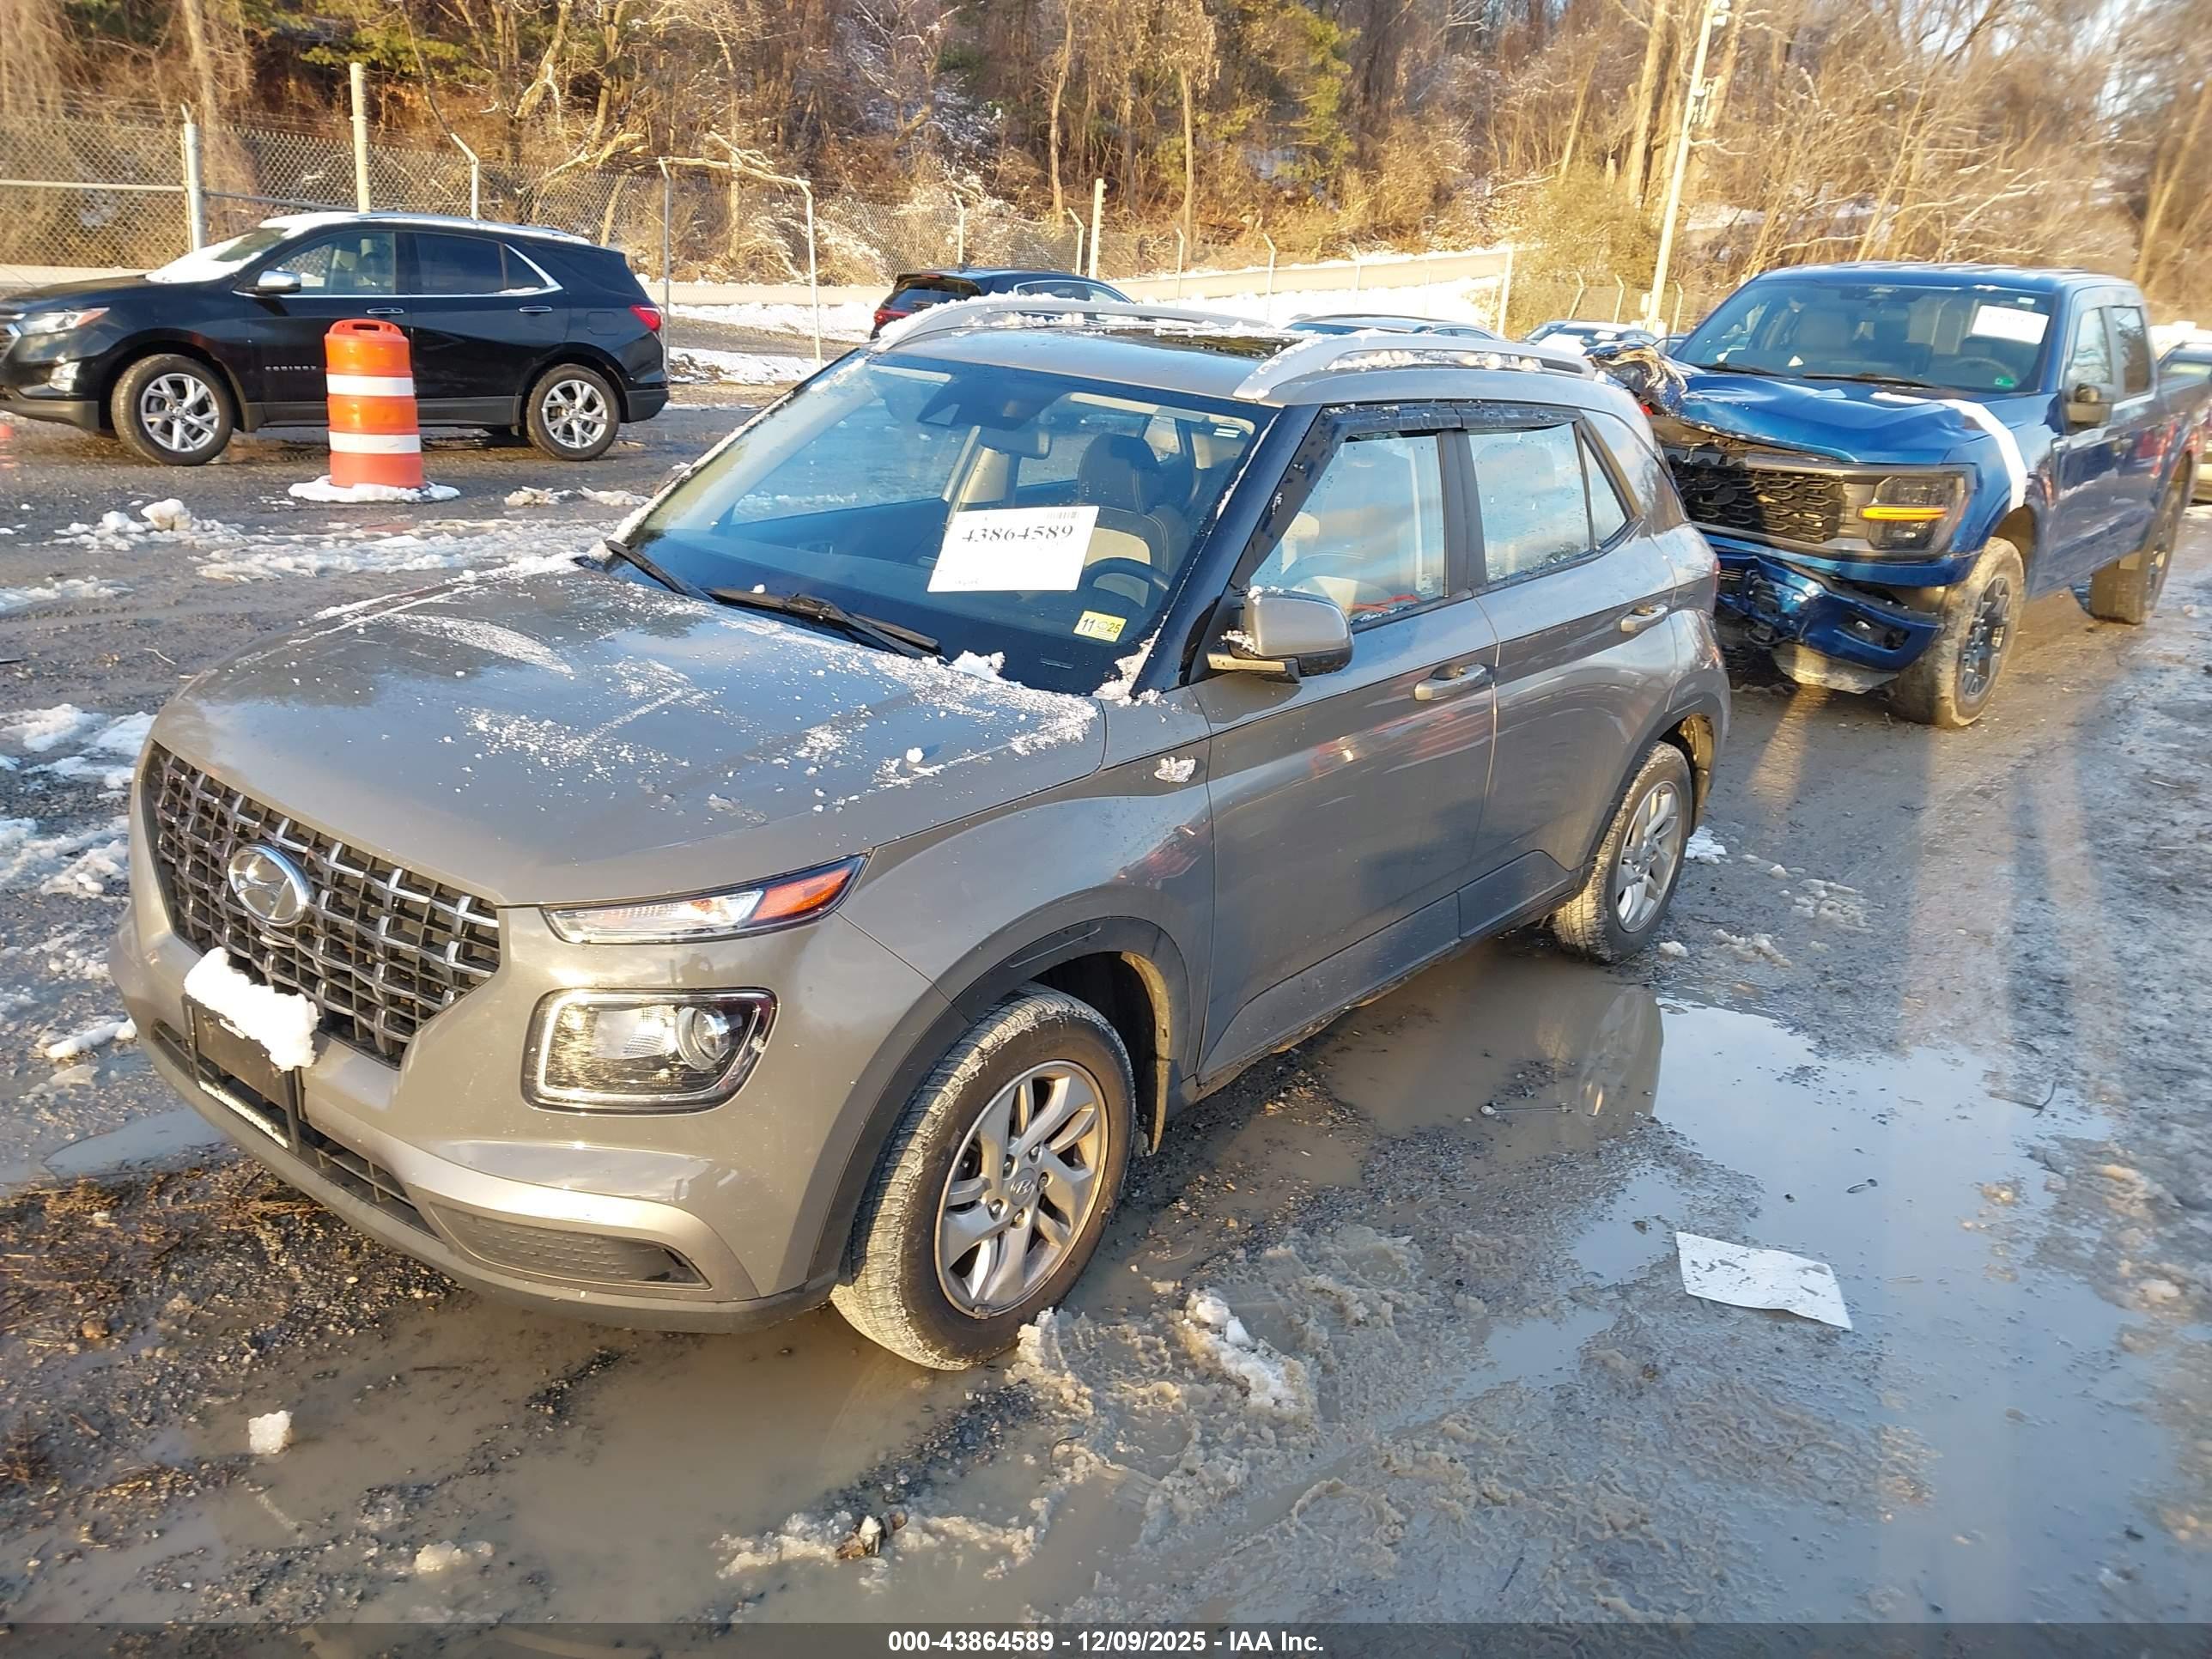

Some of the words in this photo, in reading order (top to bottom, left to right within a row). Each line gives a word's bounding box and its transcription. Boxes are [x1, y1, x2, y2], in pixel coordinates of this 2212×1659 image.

[962, 525, 1073, 543] 43864589
[1082, 618, 1096, 632] 11
[1107, 623, 1121, 634] 25
